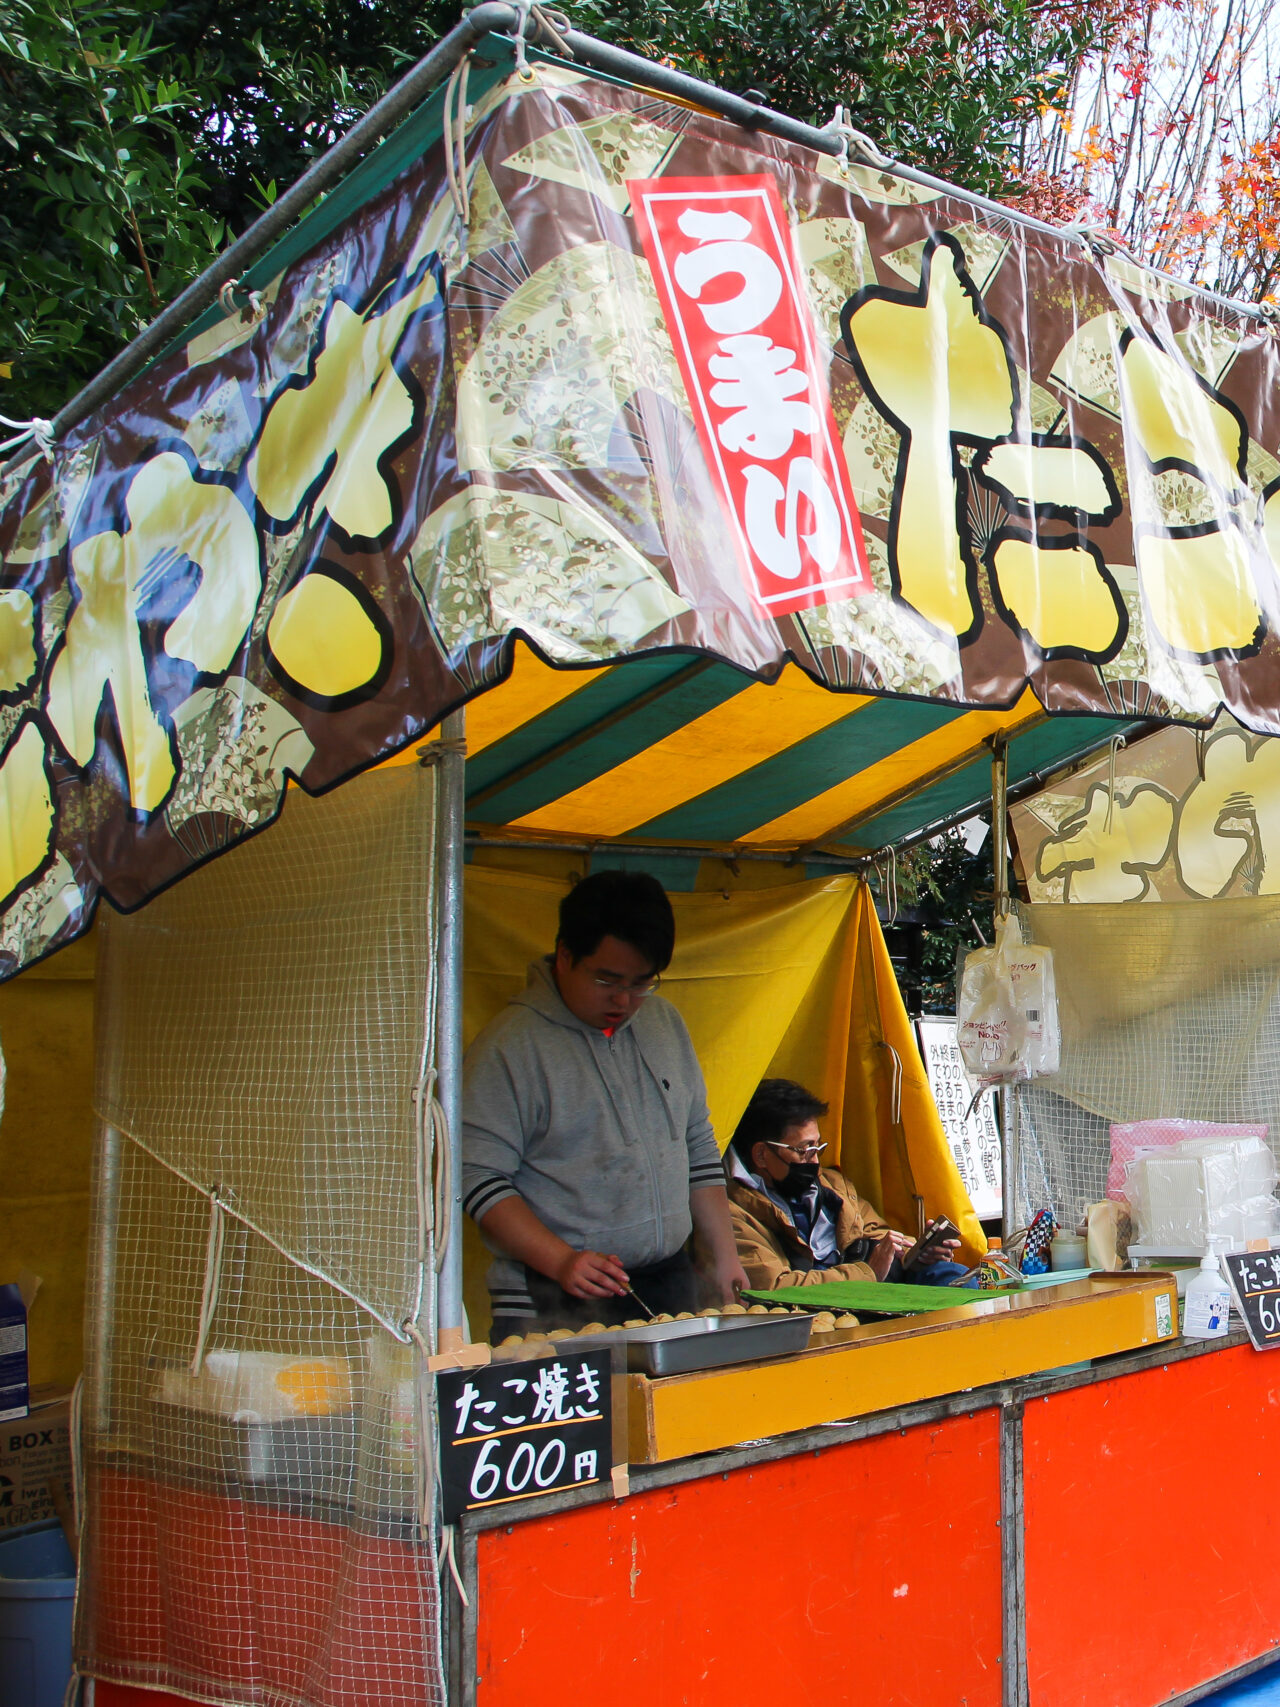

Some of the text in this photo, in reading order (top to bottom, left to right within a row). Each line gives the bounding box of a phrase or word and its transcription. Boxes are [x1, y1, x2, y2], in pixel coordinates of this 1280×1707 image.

[455, 1362, 600, 1434] たこ焼き
[9, 1429, 54, 1451] BOX
[469, 1438, 598, 1500] 600円
